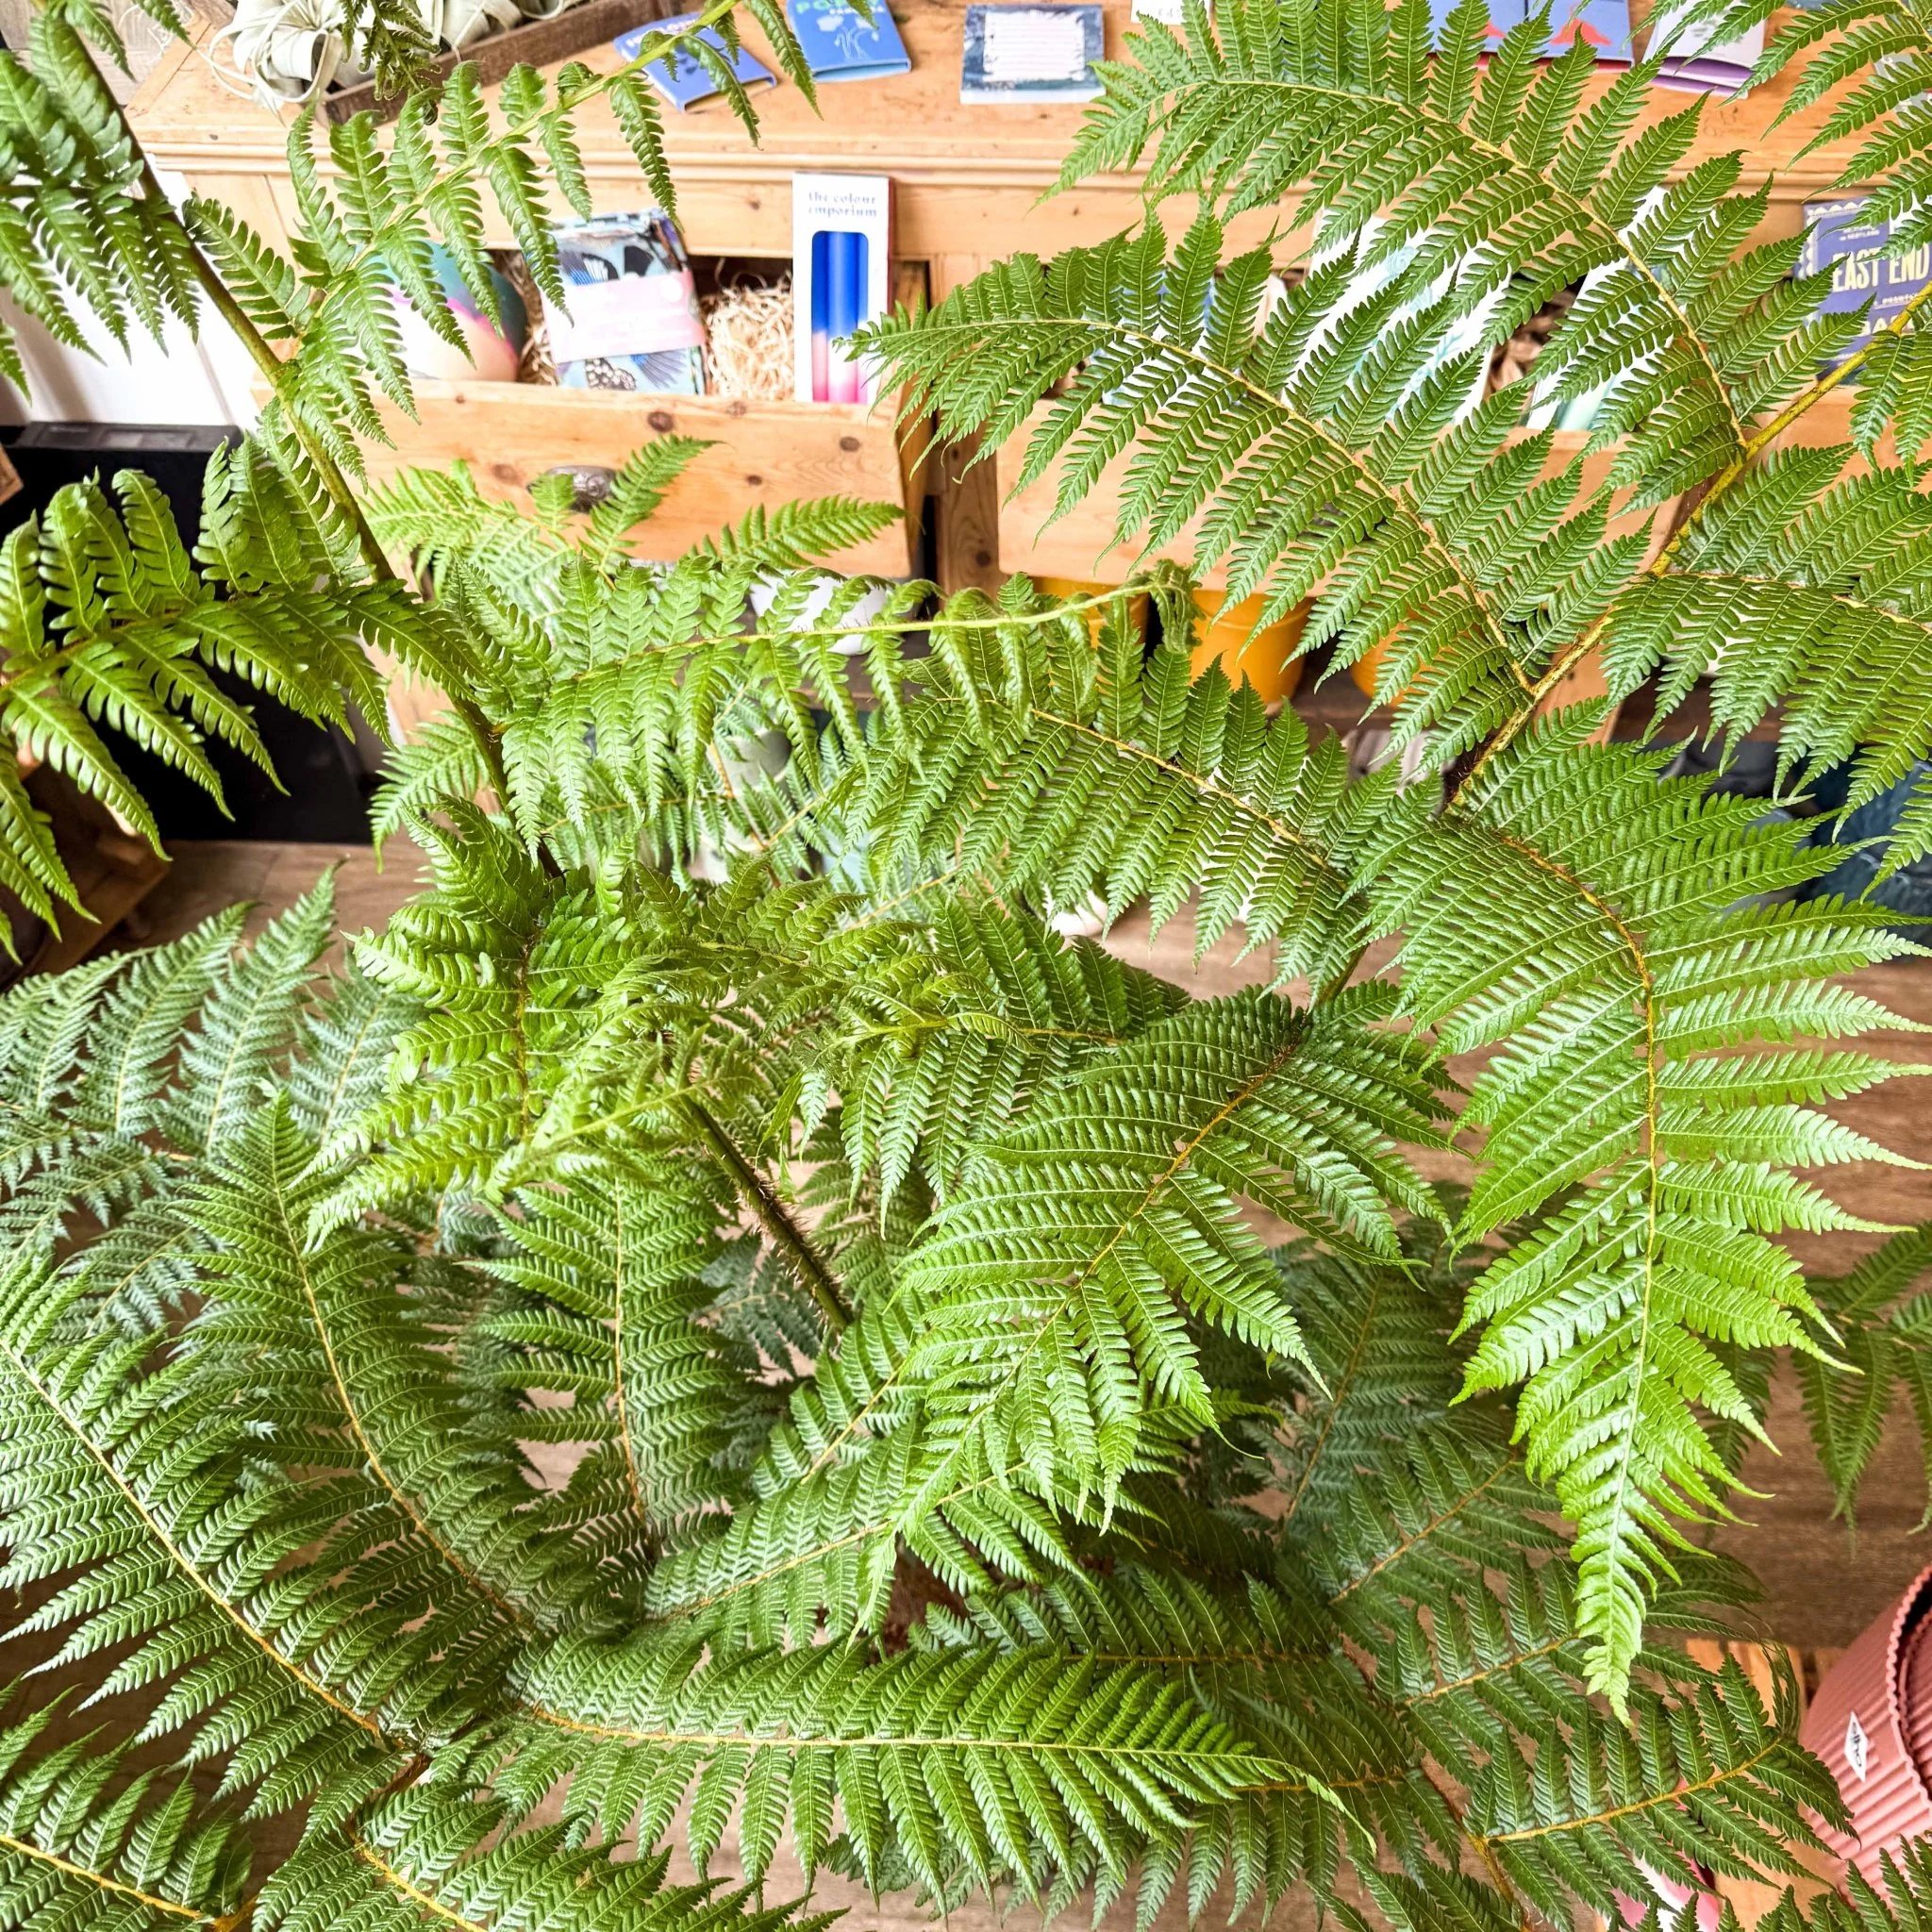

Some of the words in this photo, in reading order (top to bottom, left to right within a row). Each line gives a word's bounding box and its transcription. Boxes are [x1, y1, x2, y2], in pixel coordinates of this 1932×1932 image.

[808, 192, 828, 202] the
[833, 192, 876, 204] colour
[808, 205, 877, 218] emporium
[1832, 247, 1880, 292] EAST
[1889, 243, 1930, 284] END
